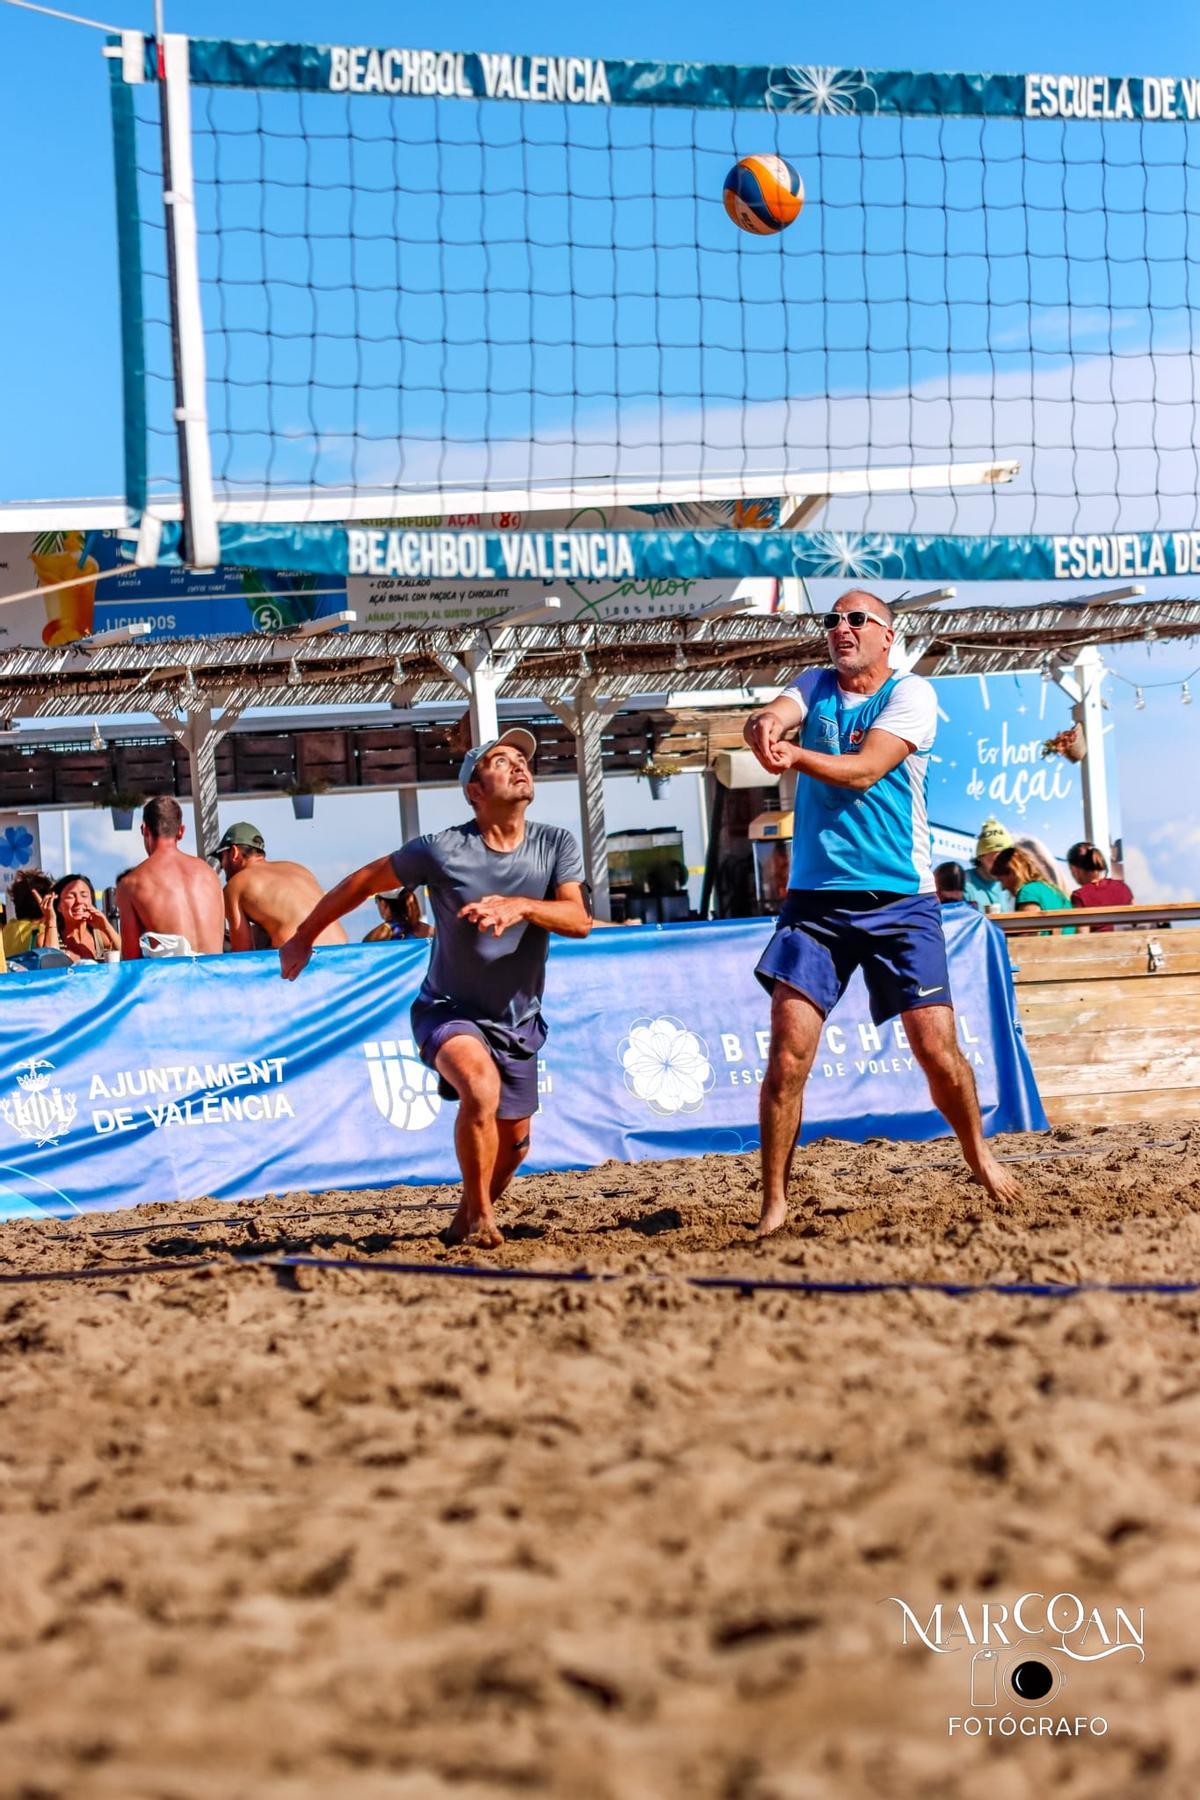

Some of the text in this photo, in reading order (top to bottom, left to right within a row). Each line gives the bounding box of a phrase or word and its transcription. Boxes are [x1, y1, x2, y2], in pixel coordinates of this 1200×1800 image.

[329, 47, 611, 103] BEACHBOL VALENCIA
[1025, 74, 1134, 118] ESCUELA
[1143, 78, 1177, 119] DE
[348, 529, 635, 578] BEACHBOL VALENCIA
[1053, 533, 1167, 578] ESCUELA
[412, 592, 427, 602] CON
[468, 587, 510, 600] CHOCOLATE
[966, 762, 1072, 814] de açaí
[89, 1057, 288, 1100] AJUNTAMENT
[823, 1063, 845, 1078] DE
[855, 1057, 913, 1075] VOLEY
[92, 1091, 296, 1134] DE VALÈNCIA
